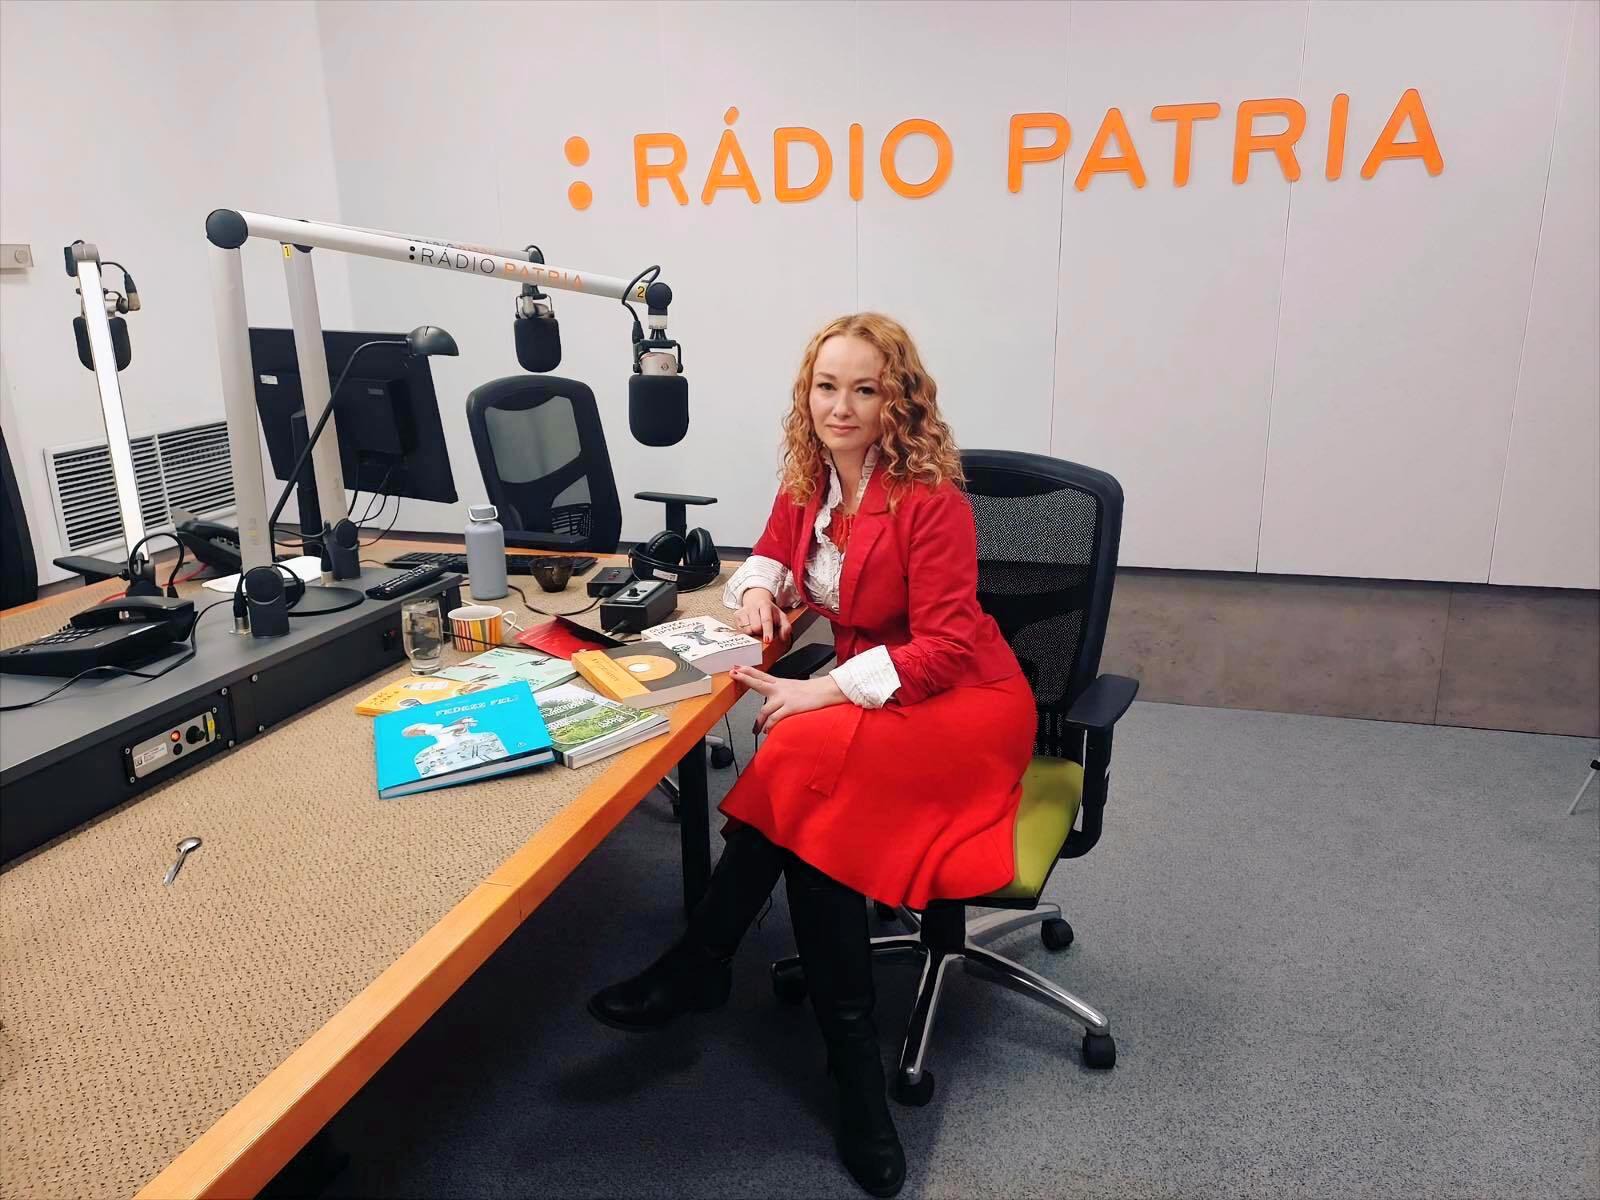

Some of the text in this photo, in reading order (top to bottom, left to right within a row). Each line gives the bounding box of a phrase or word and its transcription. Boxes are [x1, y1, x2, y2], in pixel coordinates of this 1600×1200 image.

[633, 87, 1445, 207] RÁDIO PATRIA
[420, 247, 584, 290] RÁDIO PATRIA
[636, 285, 646, 298] 2
